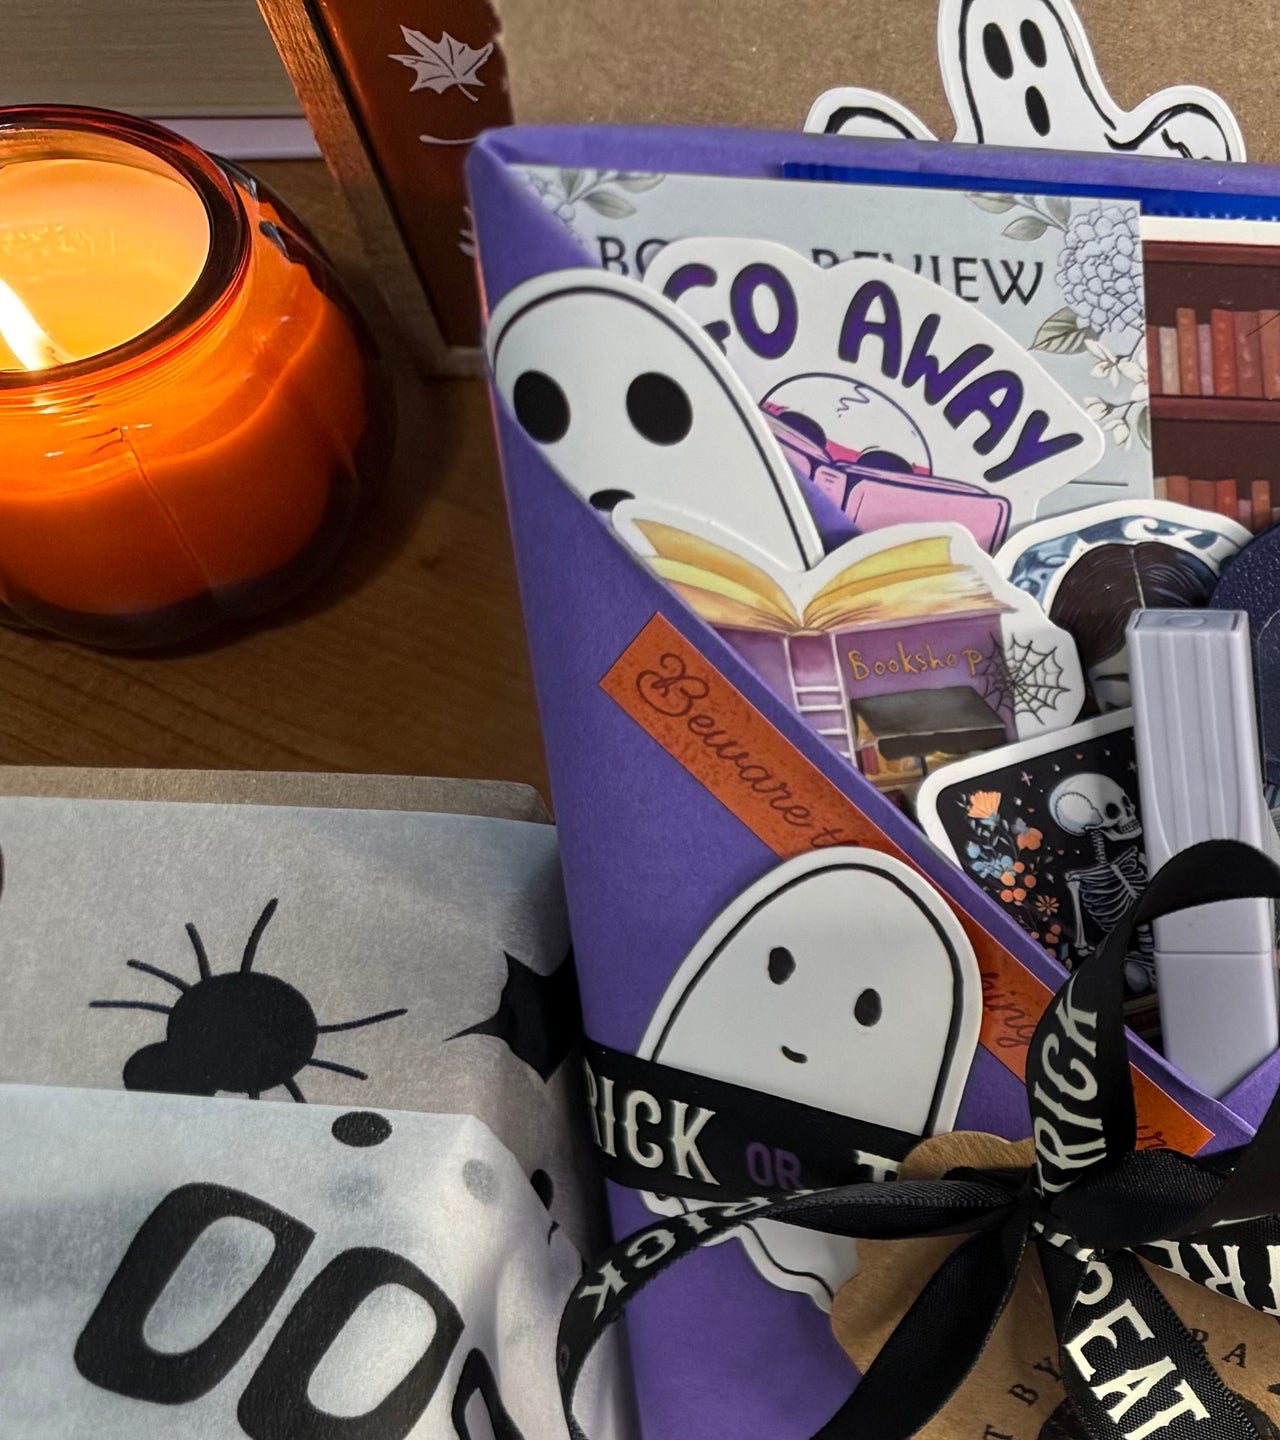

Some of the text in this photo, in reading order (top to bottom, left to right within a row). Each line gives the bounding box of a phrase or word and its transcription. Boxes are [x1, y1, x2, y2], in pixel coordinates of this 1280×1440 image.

[838, 280, 1083, 483] AWAY
[847, 641, 984, 680] Bookshop
[635, 652, 814, 829] Beware
[746, 1141, 804, 1190] OR
[1008, 1356, 1062, 1407] BY
